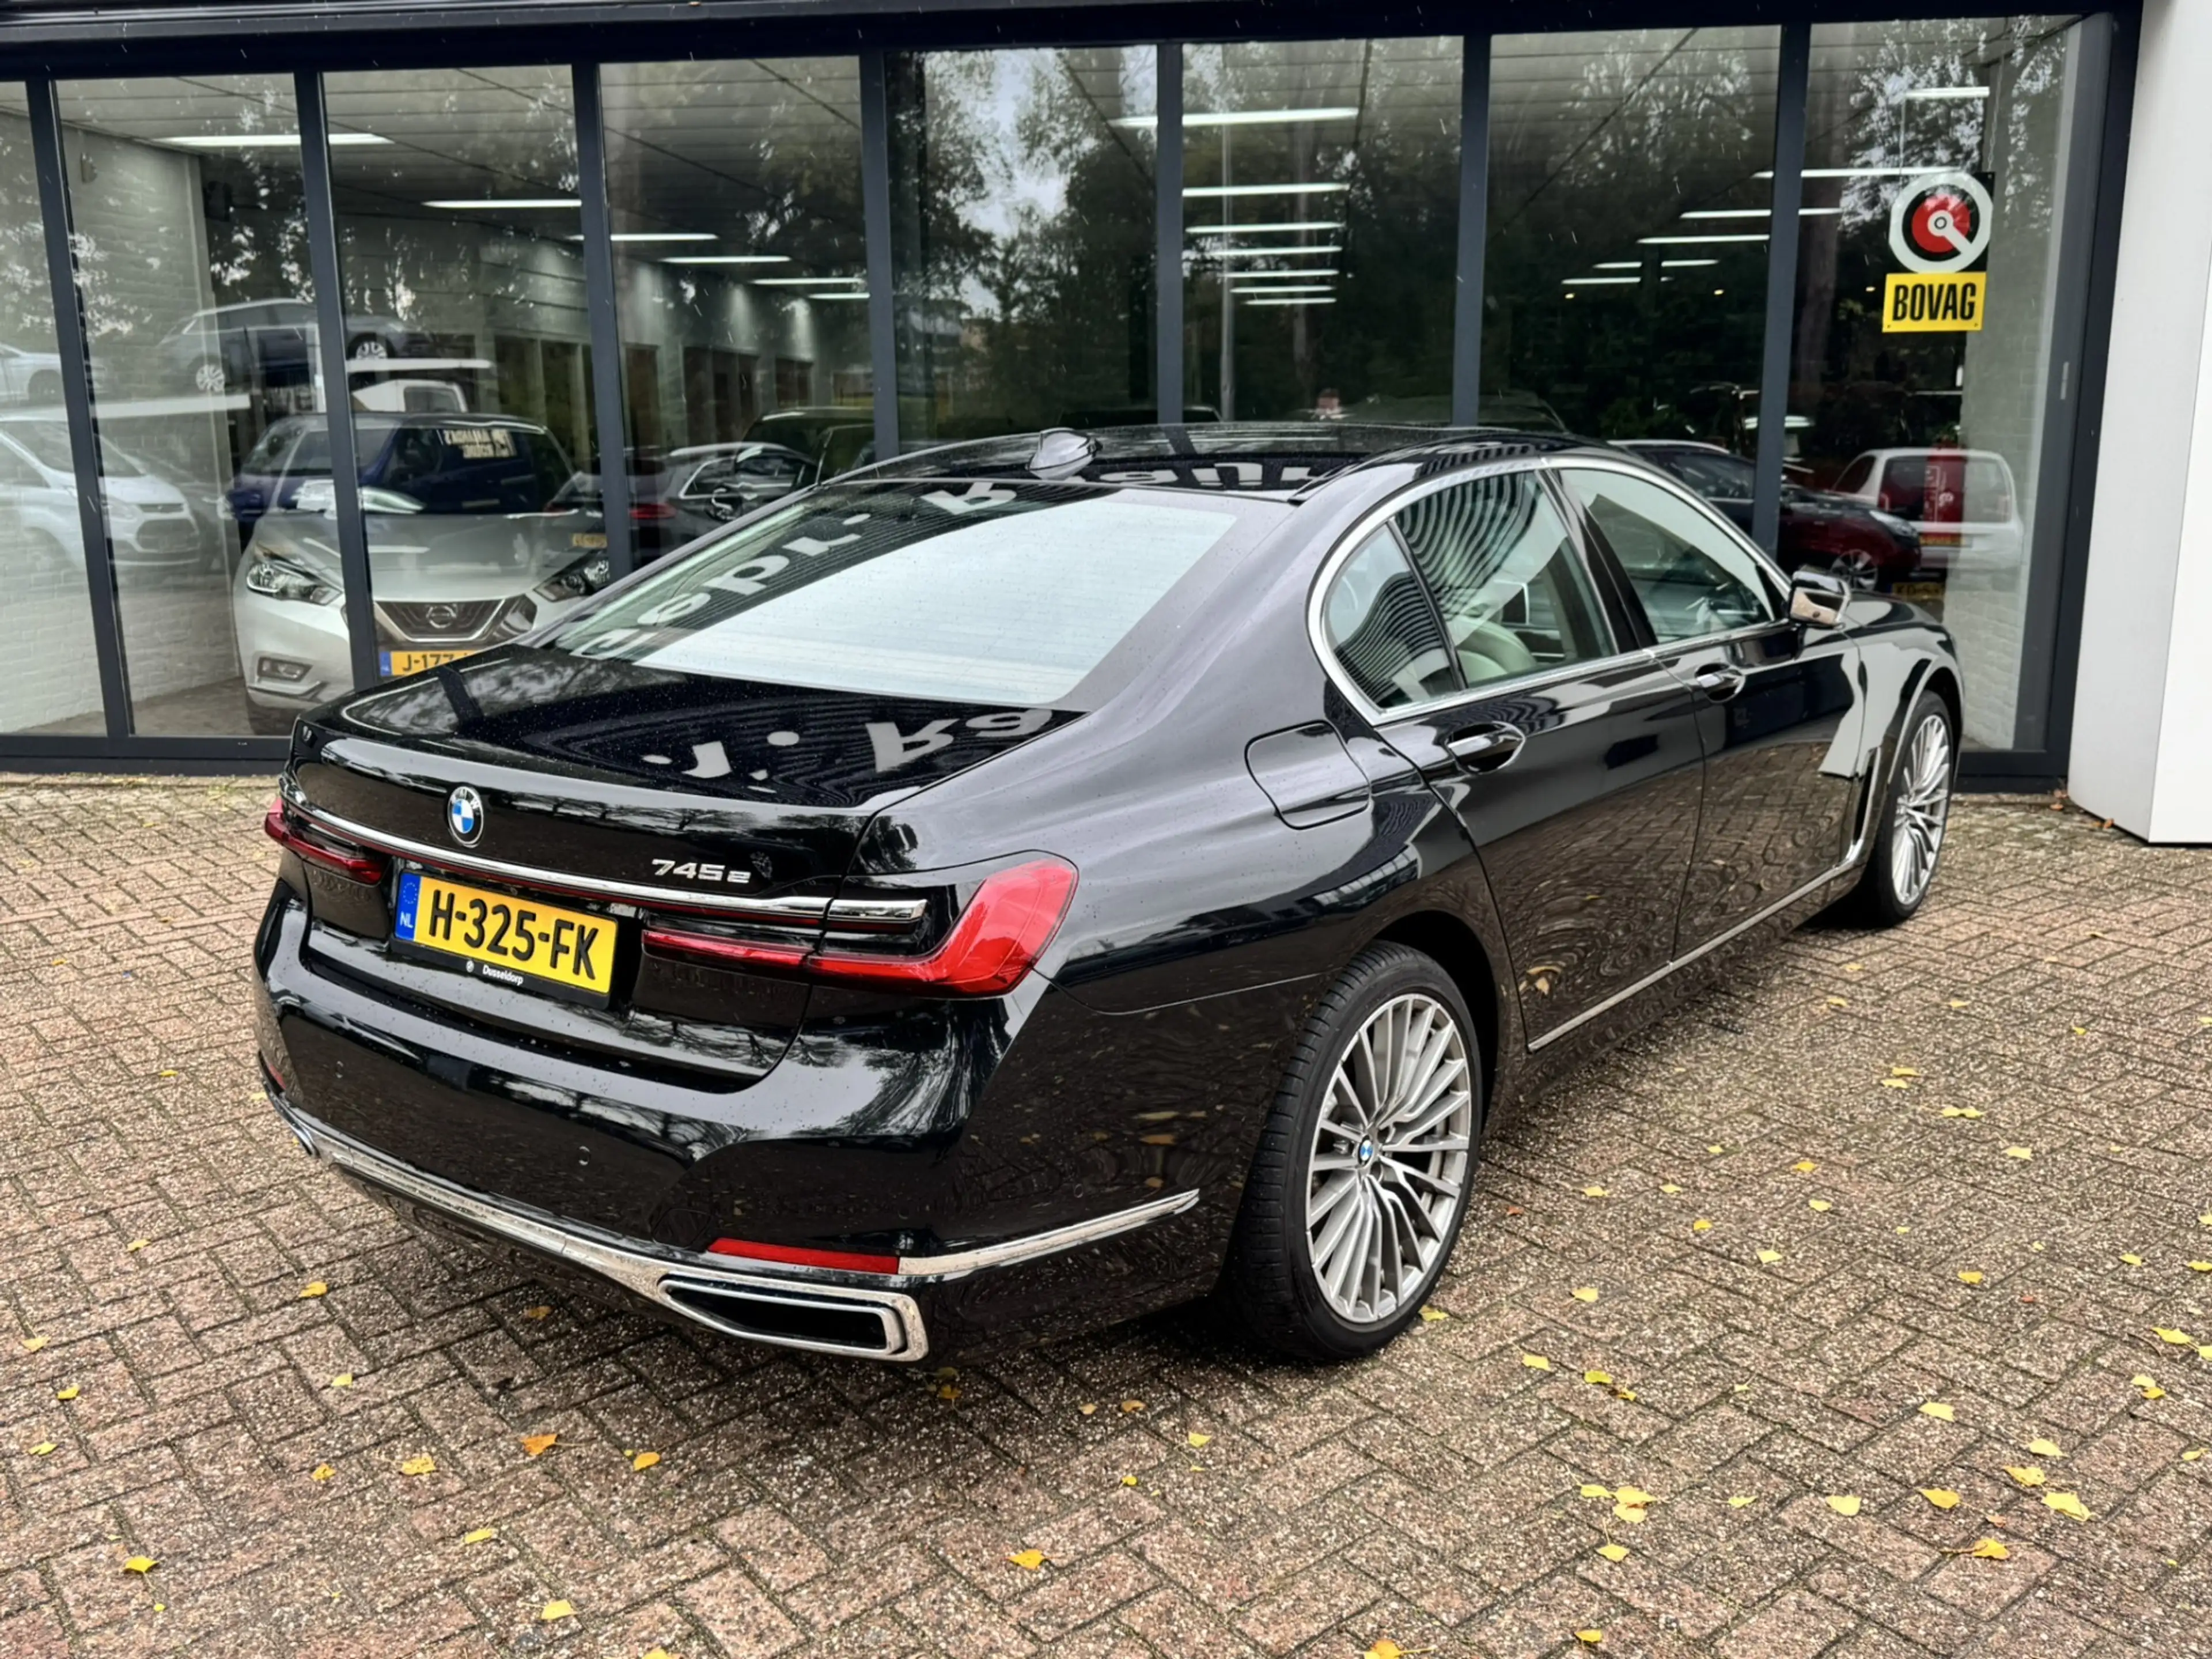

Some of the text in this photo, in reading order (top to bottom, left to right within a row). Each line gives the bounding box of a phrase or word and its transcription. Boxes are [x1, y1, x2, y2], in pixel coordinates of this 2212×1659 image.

[1892, 282, 1977, 321] BOVAG
[652, 858, 751, 884] 745e
[400, 911, 414, 929] NL
[429, 889, 599, 980] H-325-FK
[482, 964, 524, 986] Dusseldorp
